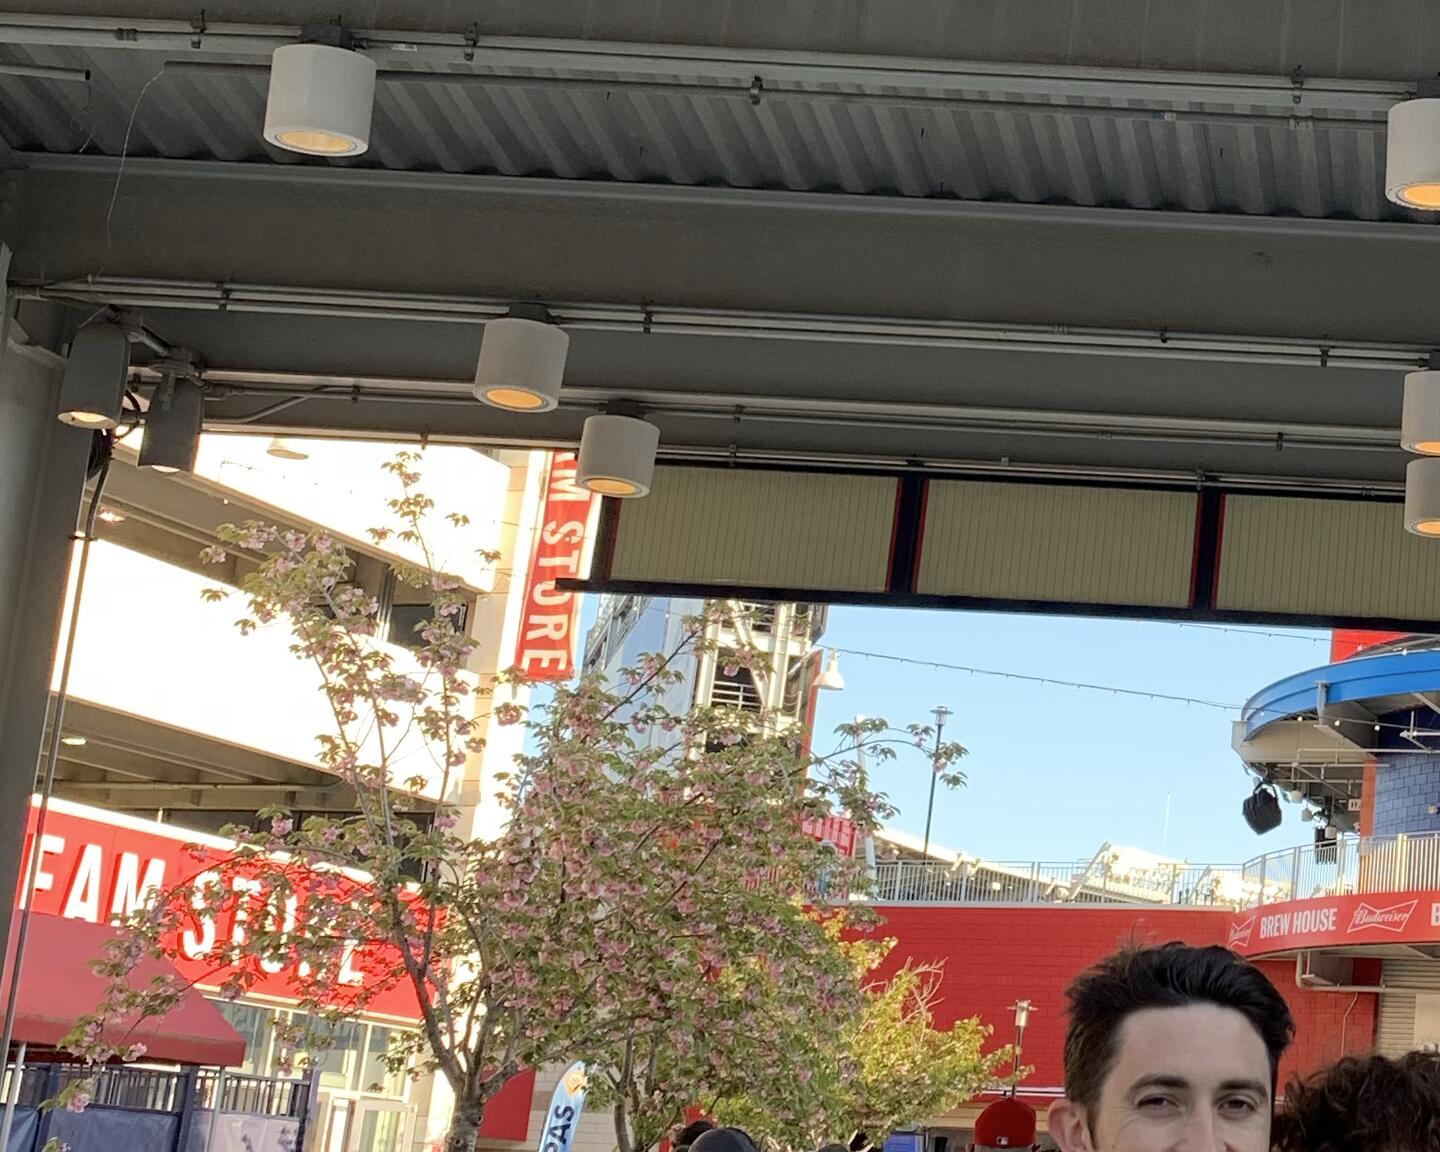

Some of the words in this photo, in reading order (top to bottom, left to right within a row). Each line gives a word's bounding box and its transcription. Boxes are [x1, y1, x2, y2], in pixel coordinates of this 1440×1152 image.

[521, 520, 585, 671] STORE
[1259, 911, 1293, 939] BREW
[1292, 907, 1338, 935] HOUSE
[1354, 905, 1409, 925] Budweiser
